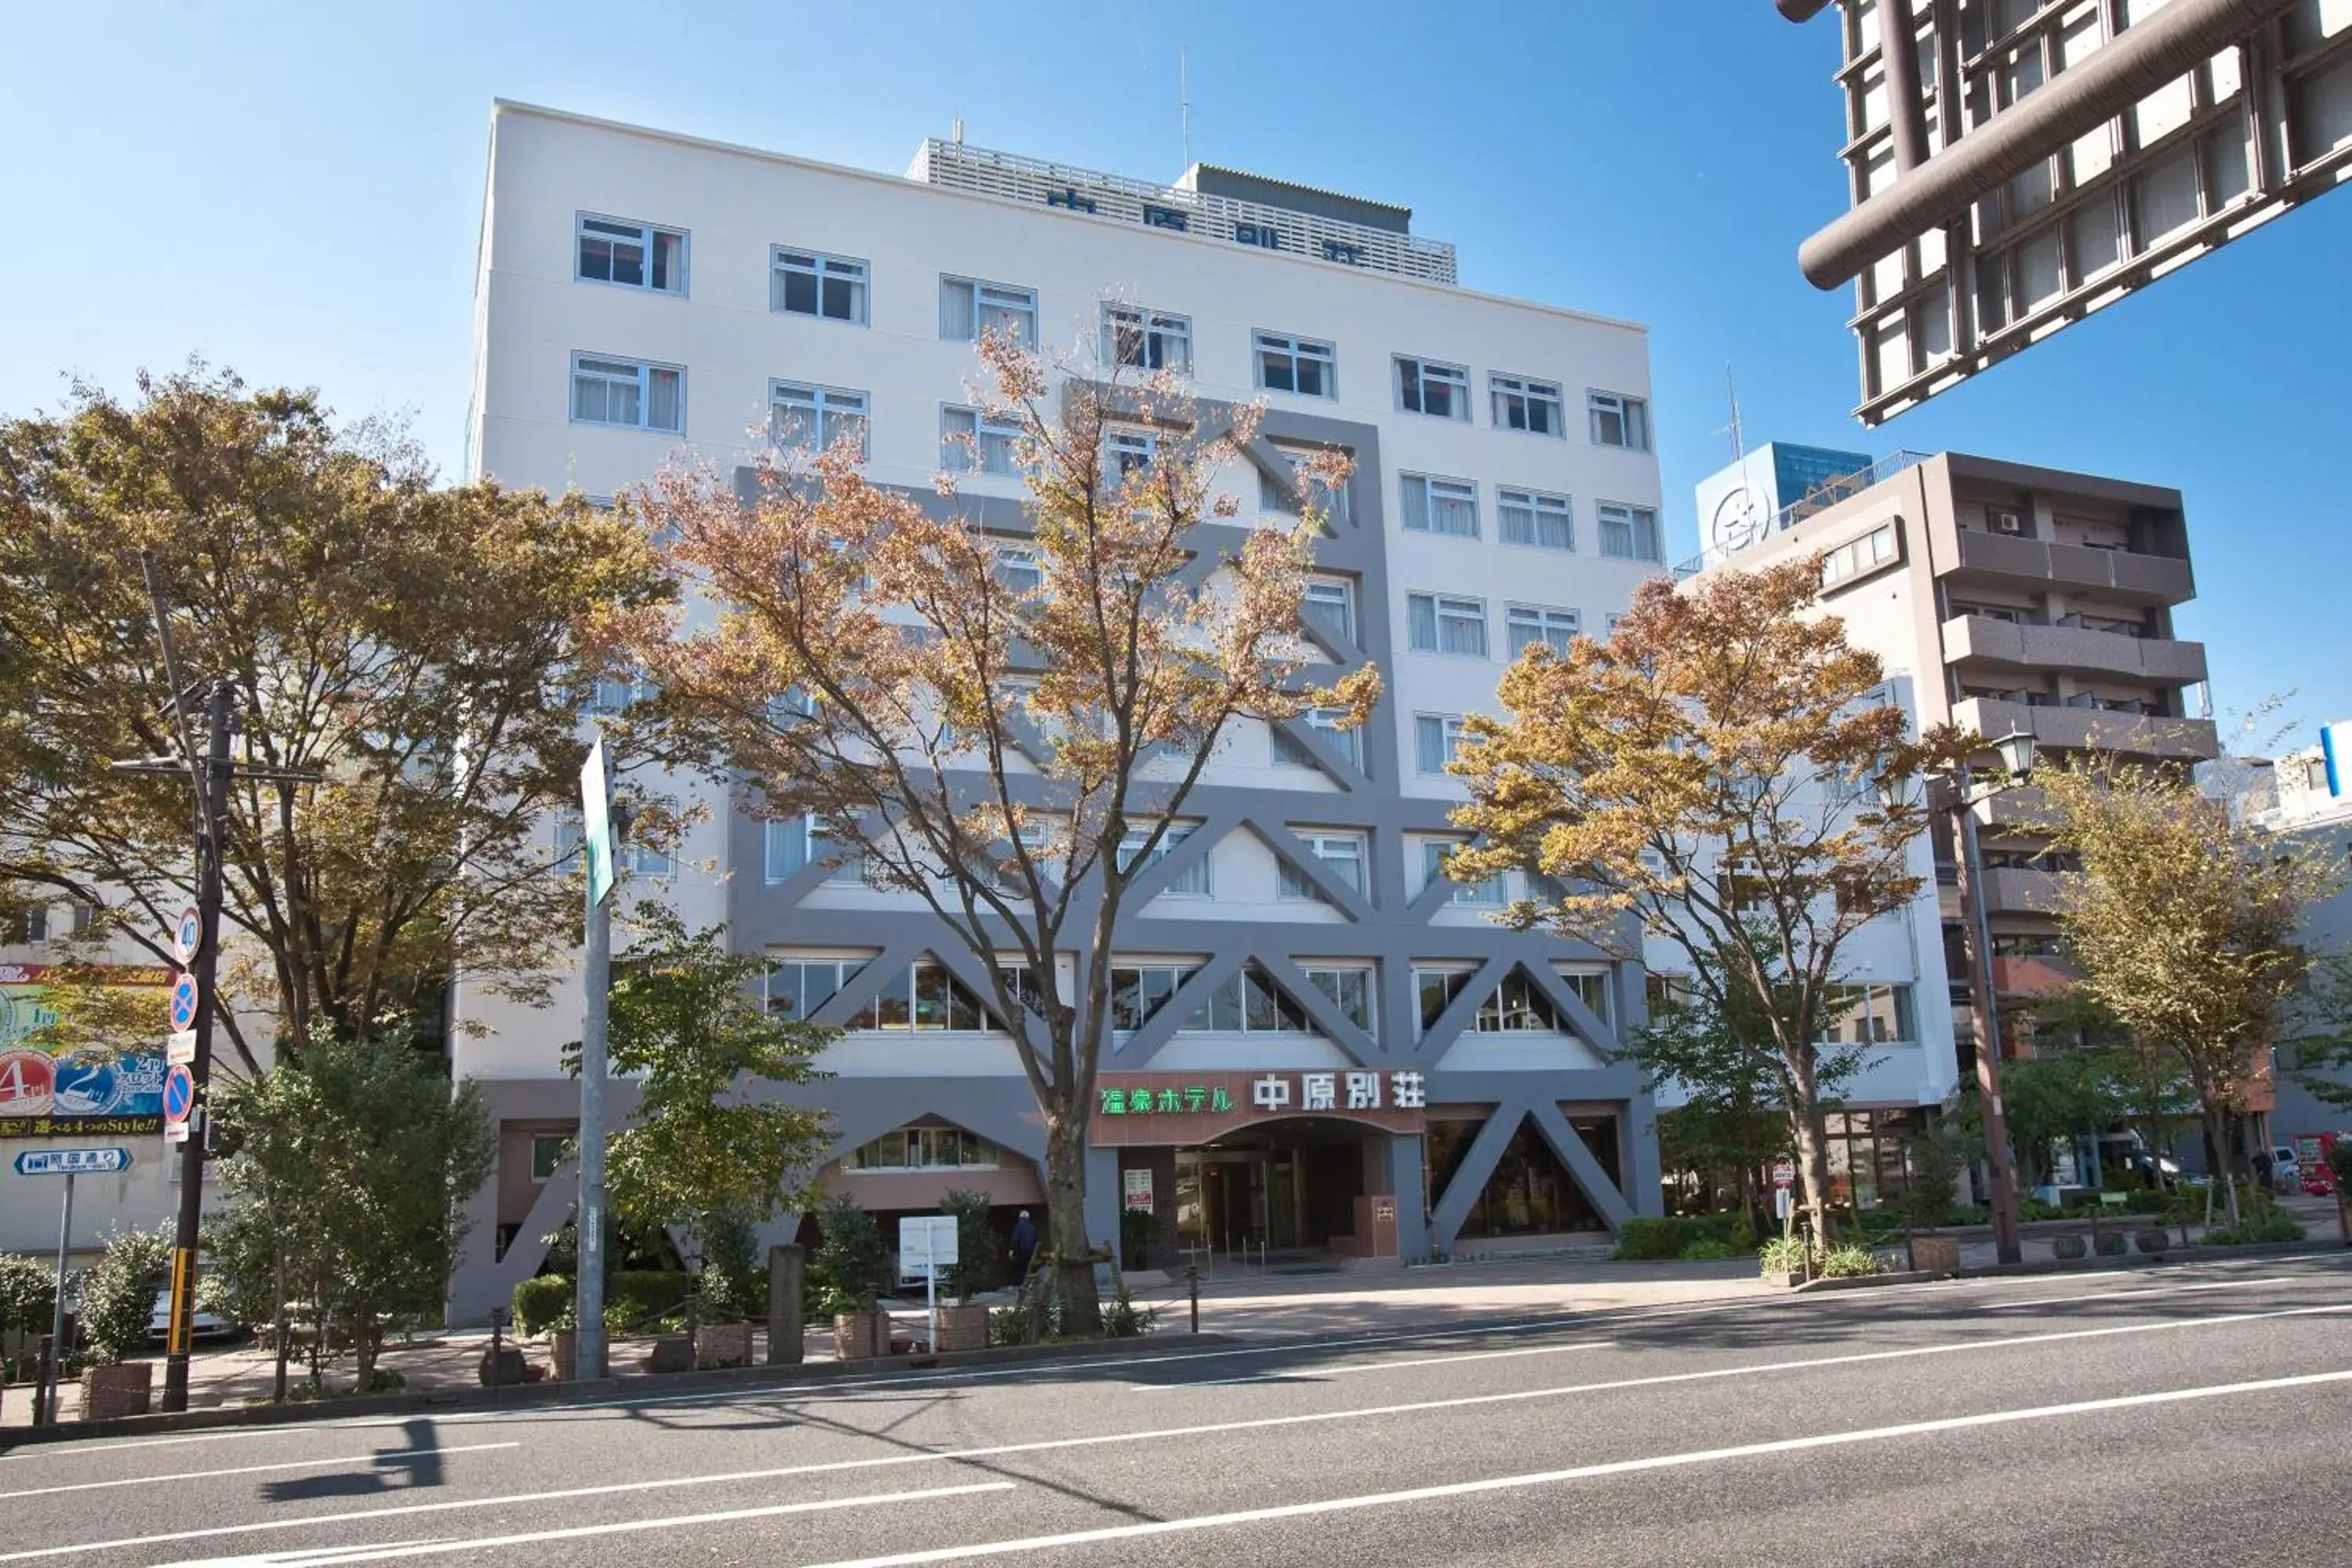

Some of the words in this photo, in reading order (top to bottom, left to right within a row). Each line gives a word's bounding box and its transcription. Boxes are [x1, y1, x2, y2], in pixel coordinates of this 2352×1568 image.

[182, 921, 194, 946] 40
[1101, 1086, 1234, 1114] 温泉ホテル
[1254, 1071, 1425, 1111] 中原別荘
